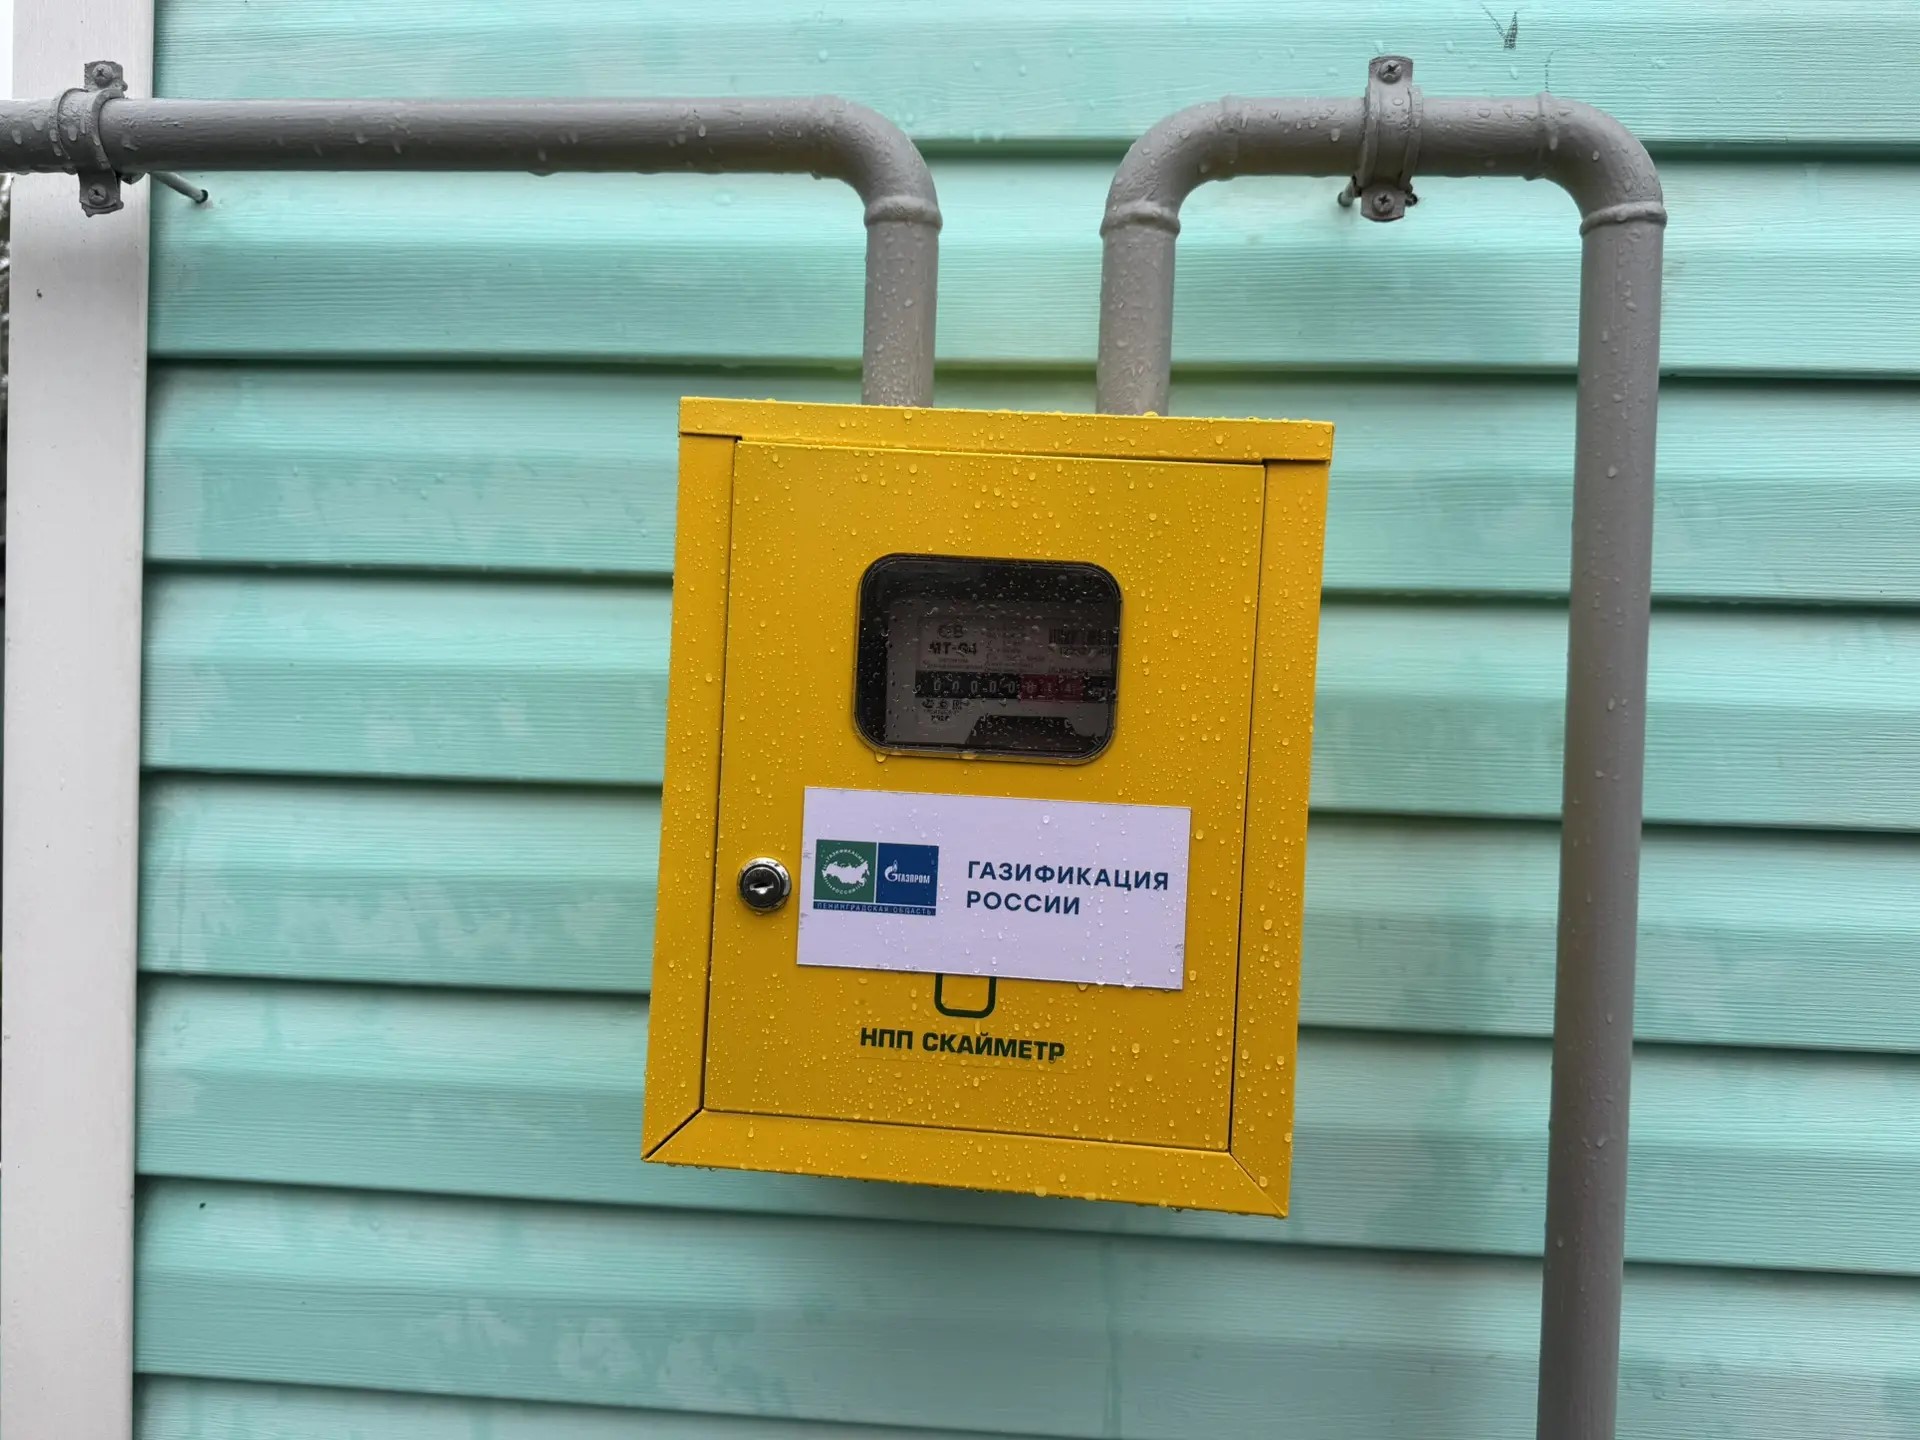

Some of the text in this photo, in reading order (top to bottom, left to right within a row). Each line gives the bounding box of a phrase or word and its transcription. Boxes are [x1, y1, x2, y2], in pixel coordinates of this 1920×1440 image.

[967, 860, 1170, 892] ГАЗИФИКАЦИЯ
[816, 902, 932, 916] ЛЕНИНГРАДСКАЯ ОБЛАСТЬ
[966, 890, 1081, 916] РОССИИ
[860, 1027, 1066, 1062] НПП СКАЙМЕТР
